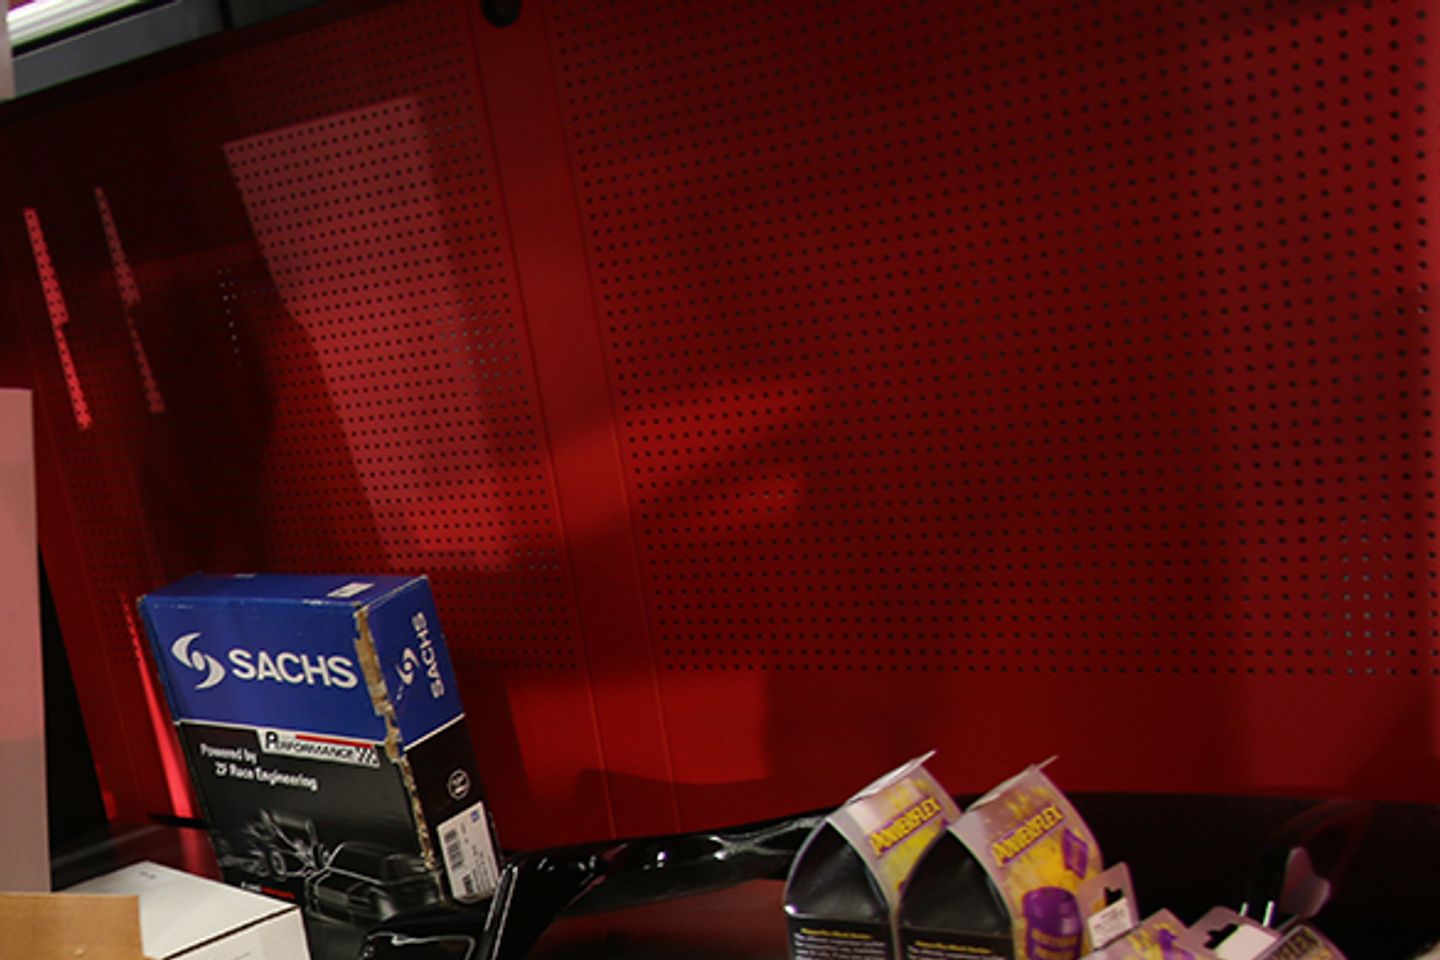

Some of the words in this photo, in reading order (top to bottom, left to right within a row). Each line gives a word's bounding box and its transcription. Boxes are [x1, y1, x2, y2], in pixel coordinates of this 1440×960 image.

[227, 648, 359, 690] SACHS
[411, 612, 445, 699] SACHS
[200, 742, 242, 761] Powered
[244, 748, 258, 764] by
[215, 761, 228, 777] ZF
[229, 764, 255, 780] Race
[256, 767, 319, 792] Engineering
